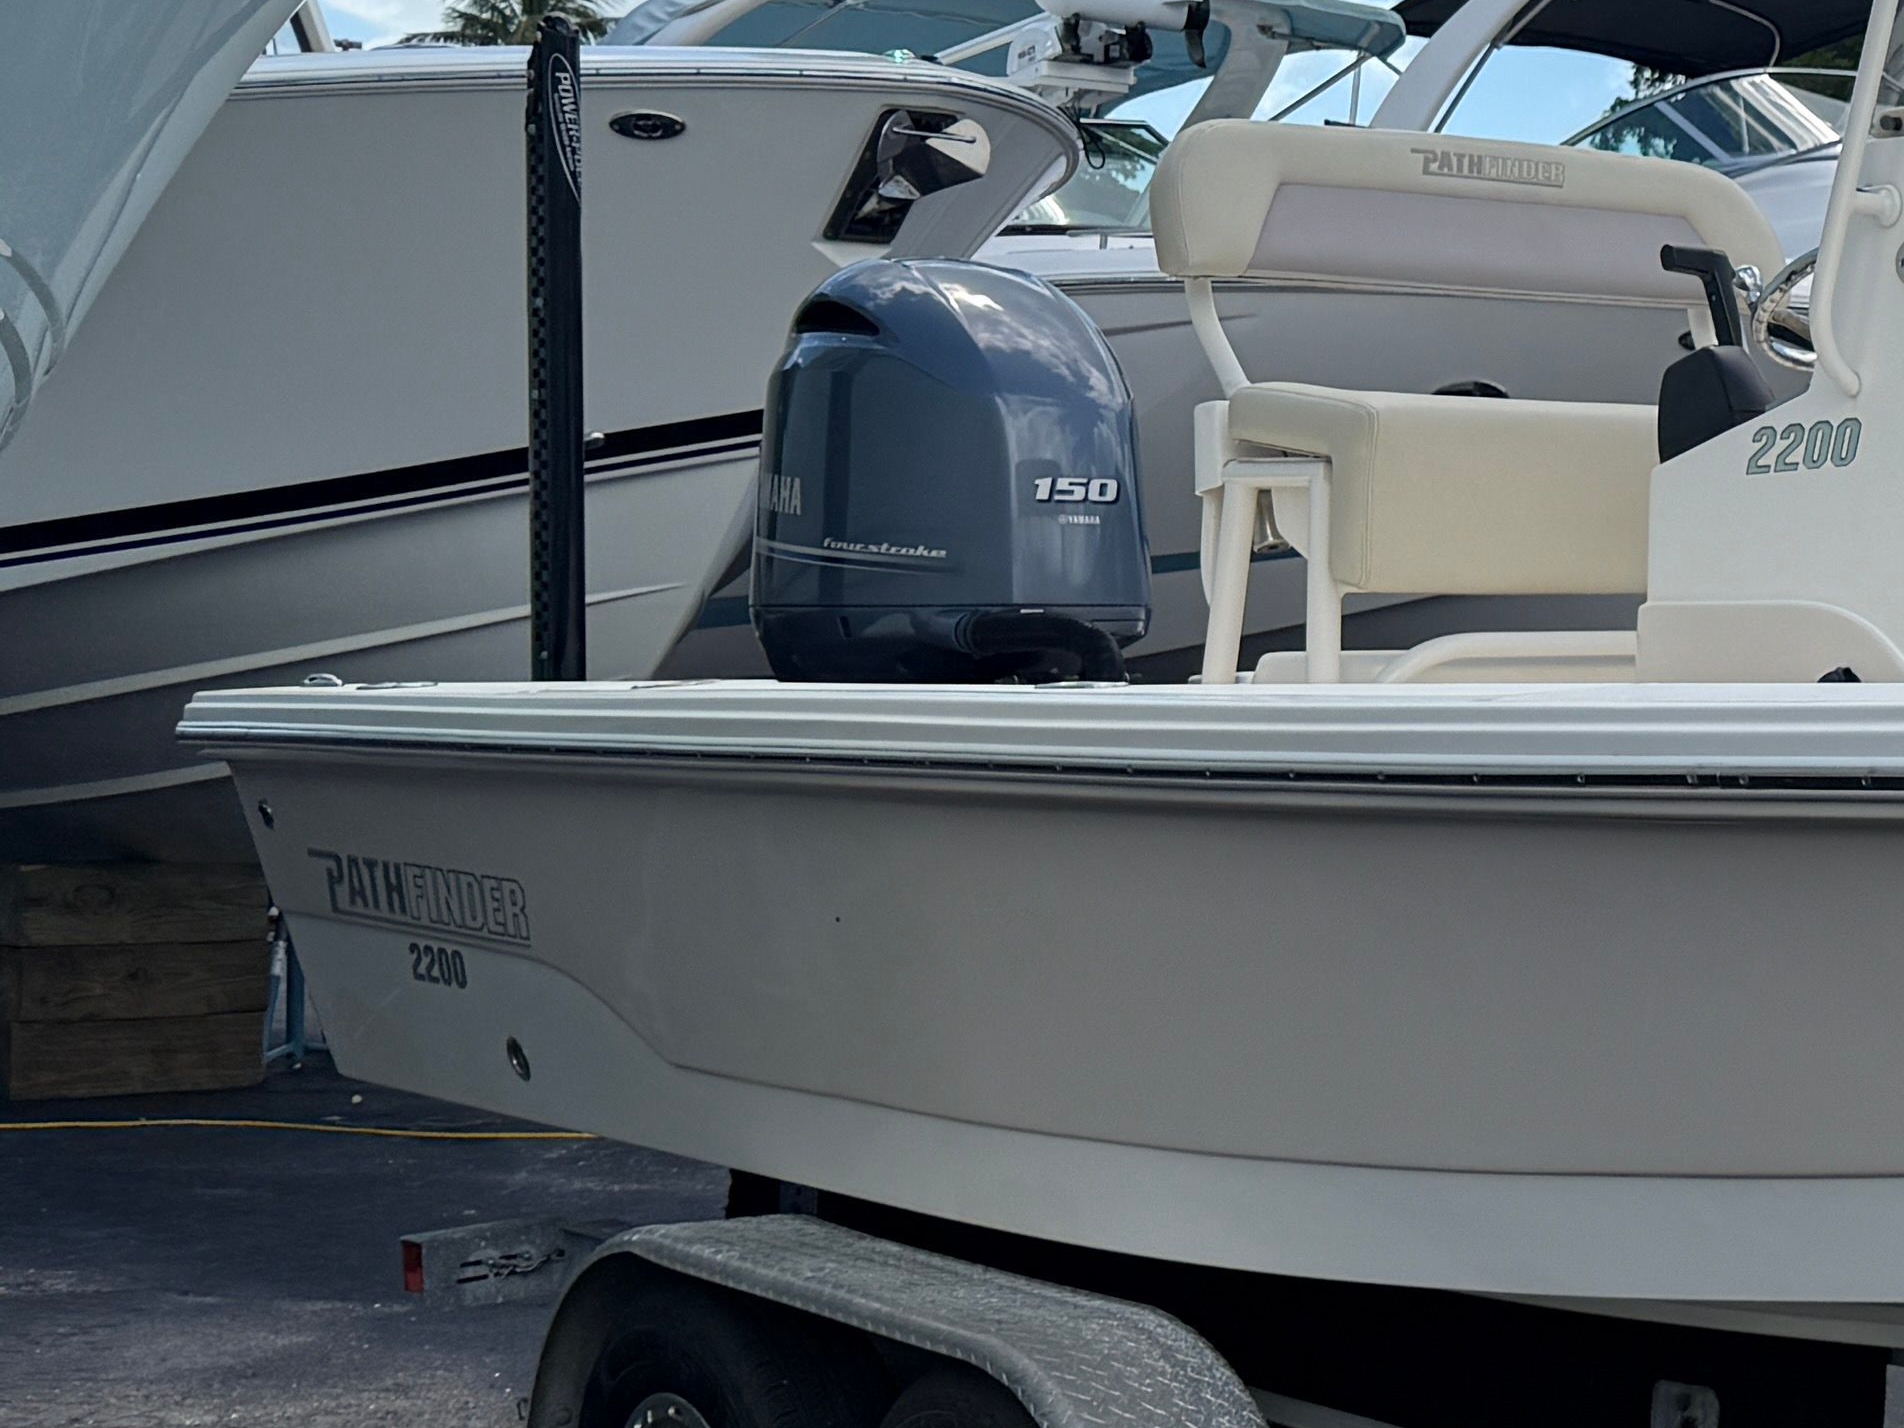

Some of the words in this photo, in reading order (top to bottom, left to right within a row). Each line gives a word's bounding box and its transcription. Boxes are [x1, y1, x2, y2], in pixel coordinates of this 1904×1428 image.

[1410, 147, 1565, 188] PATHFINDER
[1746, 417, 1862, 475] 2200
[1034, 477, 1119, 503] 150
[307, 846, 531, 949] PATHFINDER
[408, 942, 468, 990] 2200
